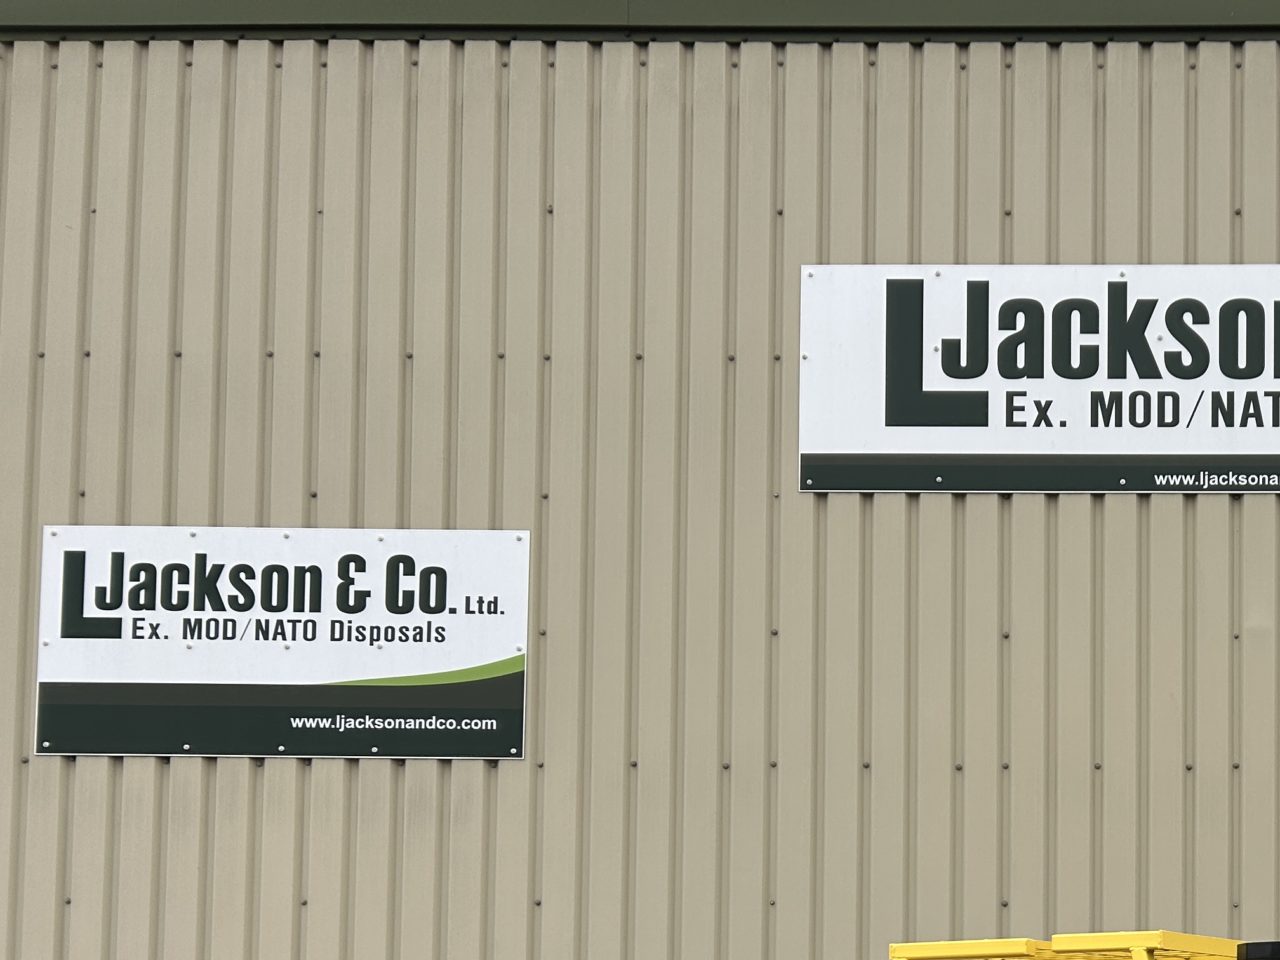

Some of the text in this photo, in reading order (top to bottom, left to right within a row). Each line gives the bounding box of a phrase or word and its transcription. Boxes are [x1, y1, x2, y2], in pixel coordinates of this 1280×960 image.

[1005, 390, 1067, 428] Ex.
[336, 553, 372, 615] &
[385, 554, 457, 615] Co.
[465, 595, 505, 615] Ltd.
[131, 617, 446, 647] Ex. MOD/NATO Disposals
[290, 714, 497, 732] www.ljacksonandco.com
